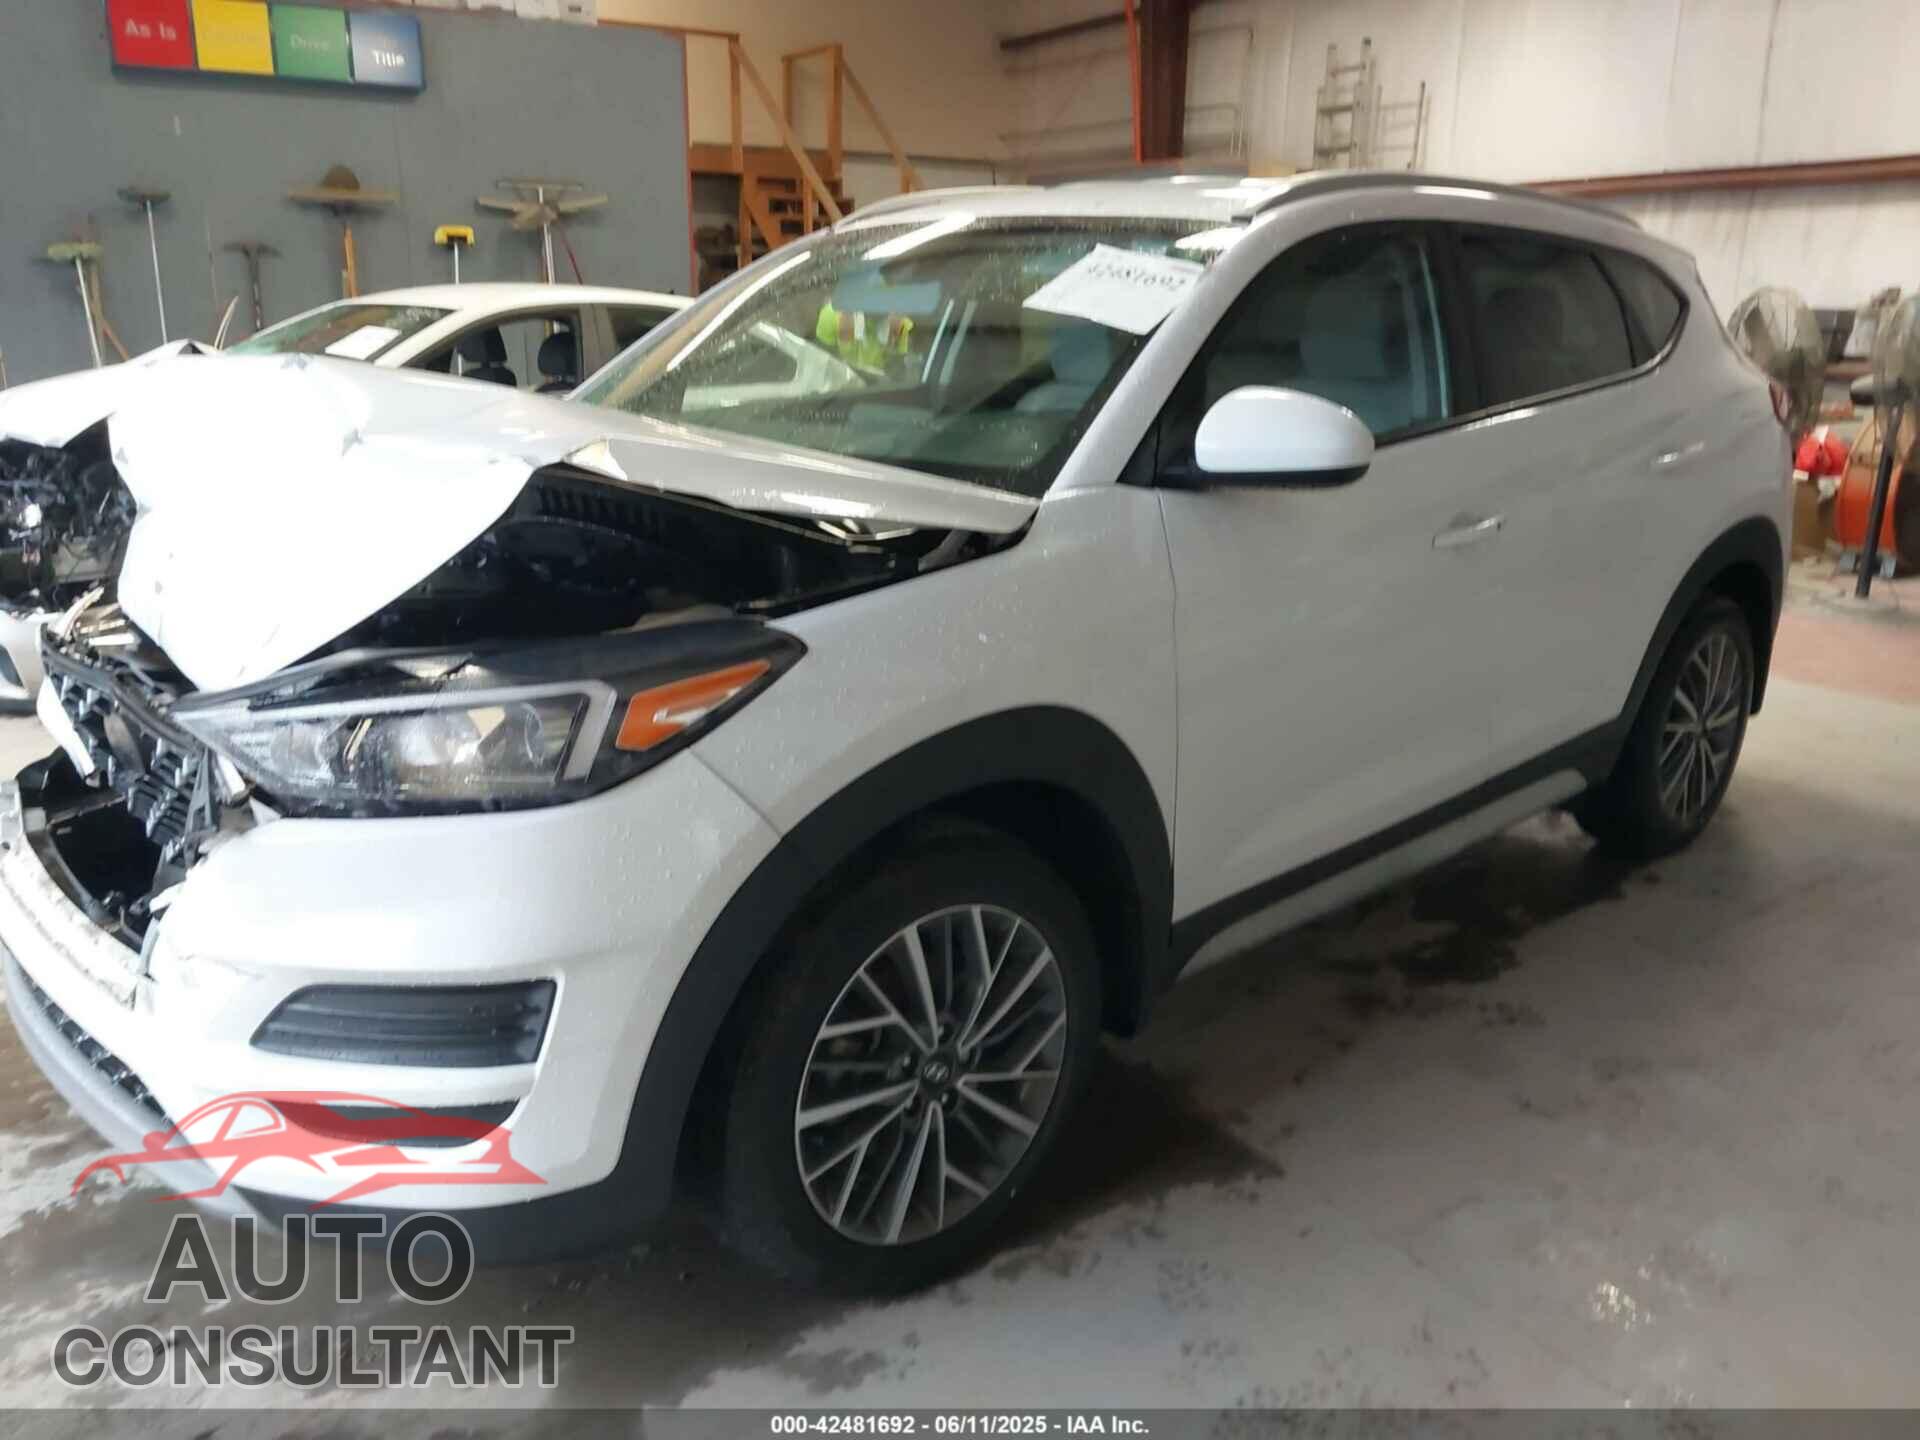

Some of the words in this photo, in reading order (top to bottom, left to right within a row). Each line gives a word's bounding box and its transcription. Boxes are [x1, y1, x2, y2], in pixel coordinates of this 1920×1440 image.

[124, 19, 151, 38] As
[159, 22, 177, 41] Is
[372, 50, 406, 68] Title
